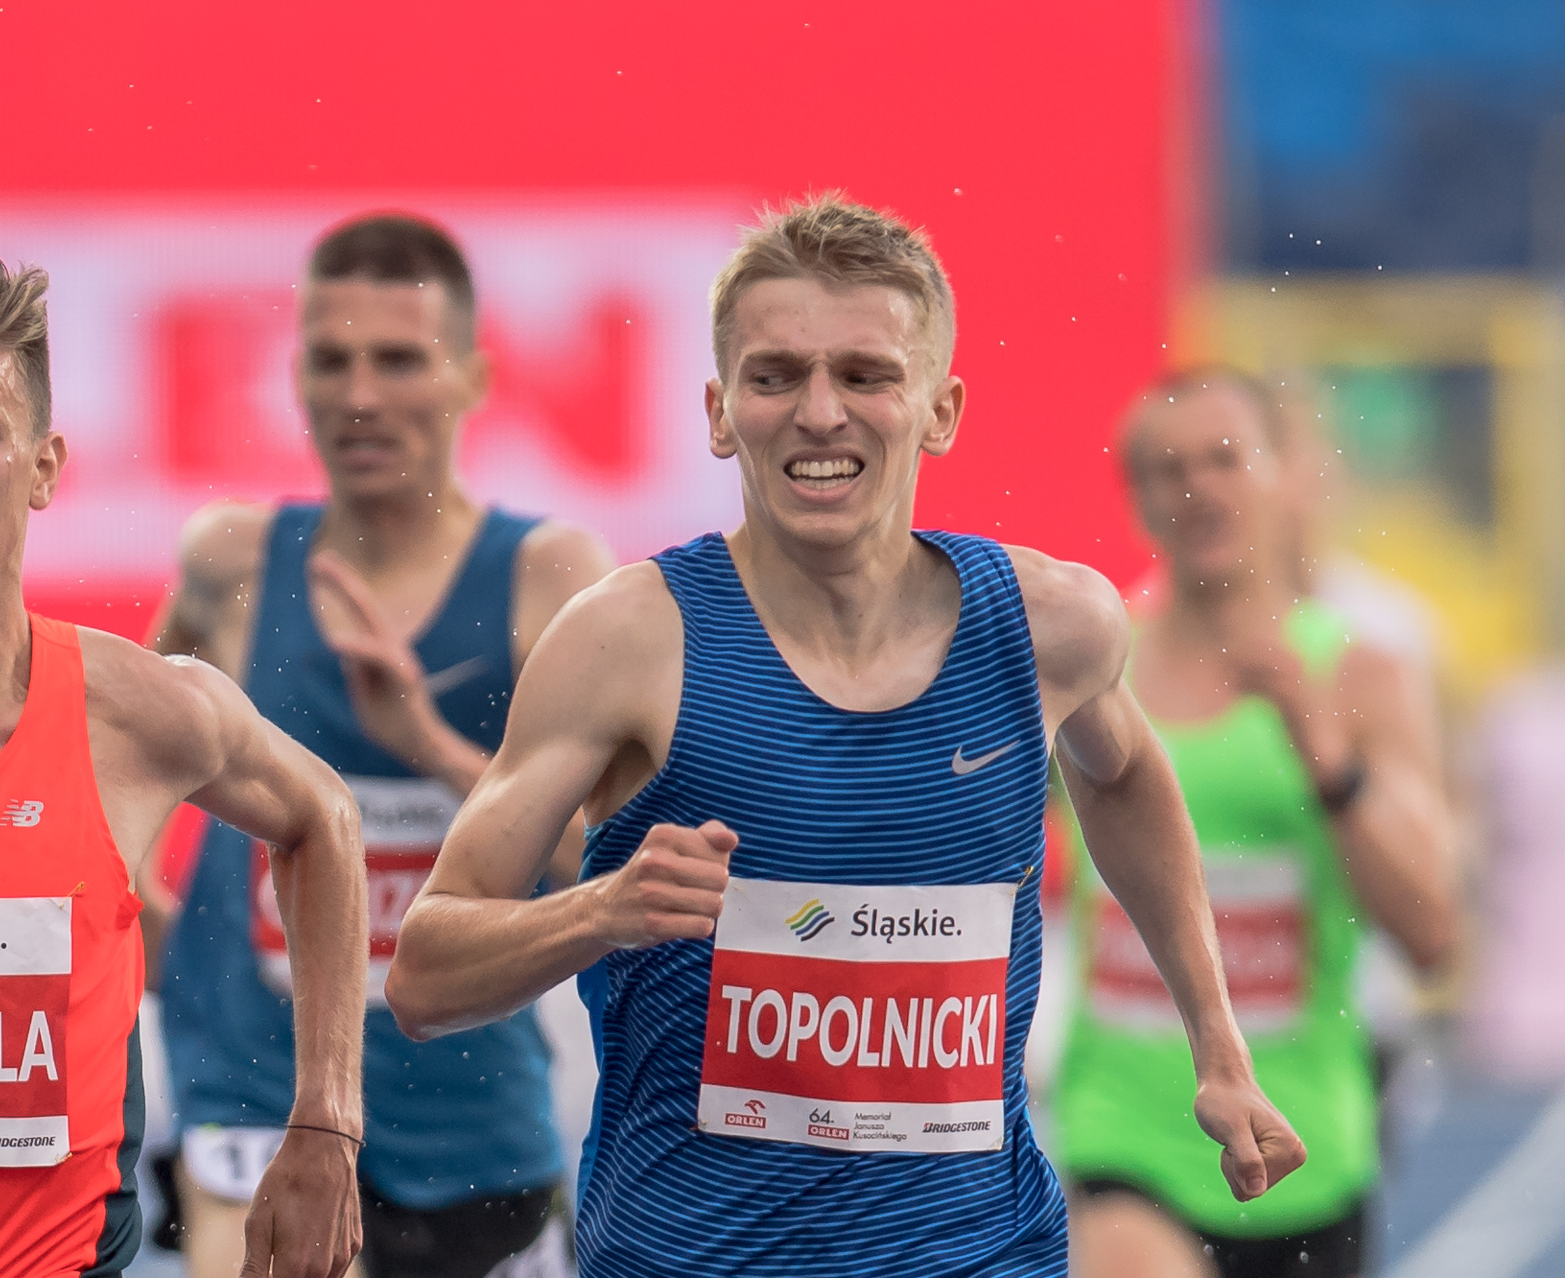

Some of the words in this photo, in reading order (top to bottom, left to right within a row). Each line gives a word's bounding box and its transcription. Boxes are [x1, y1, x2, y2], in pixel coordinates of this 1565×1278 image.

[850, 903, 963, 944] Śląskie.
[721, 984, 998, 1069] TOPOLNICKI
[726, 1115, 764, 1127] ORLEN
[808, 1107, 835, 1124] 64.
[809, 1126, 848, 1139] ORLEN
[922, 1121, 991, 1133] BRIDGESTONE
